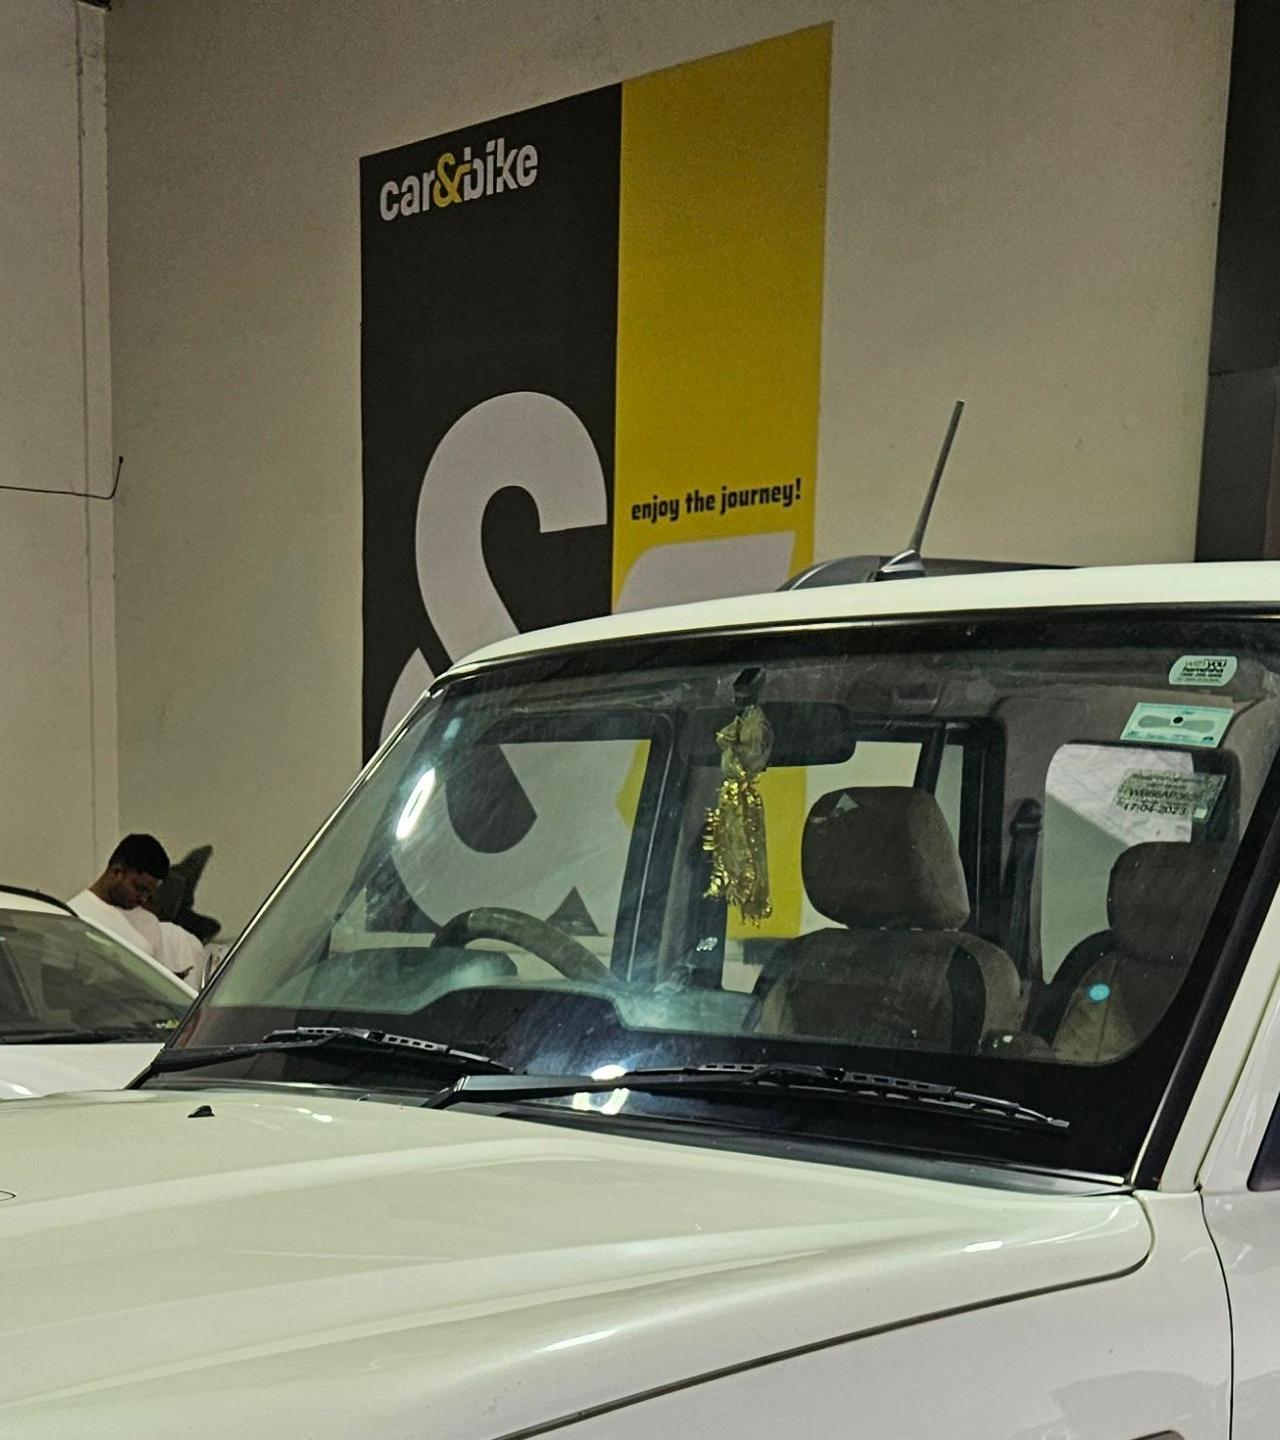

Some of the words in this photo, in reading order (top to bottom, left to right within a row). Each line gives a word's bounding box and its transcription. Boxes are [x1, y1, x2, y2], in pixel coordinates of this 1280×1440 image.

[379, 137, 539, 222] car&bike
[631, 494, 680, 525] enjoy
[685, 489, 716, 514] the
[720, 477, 802, 516] journey!
